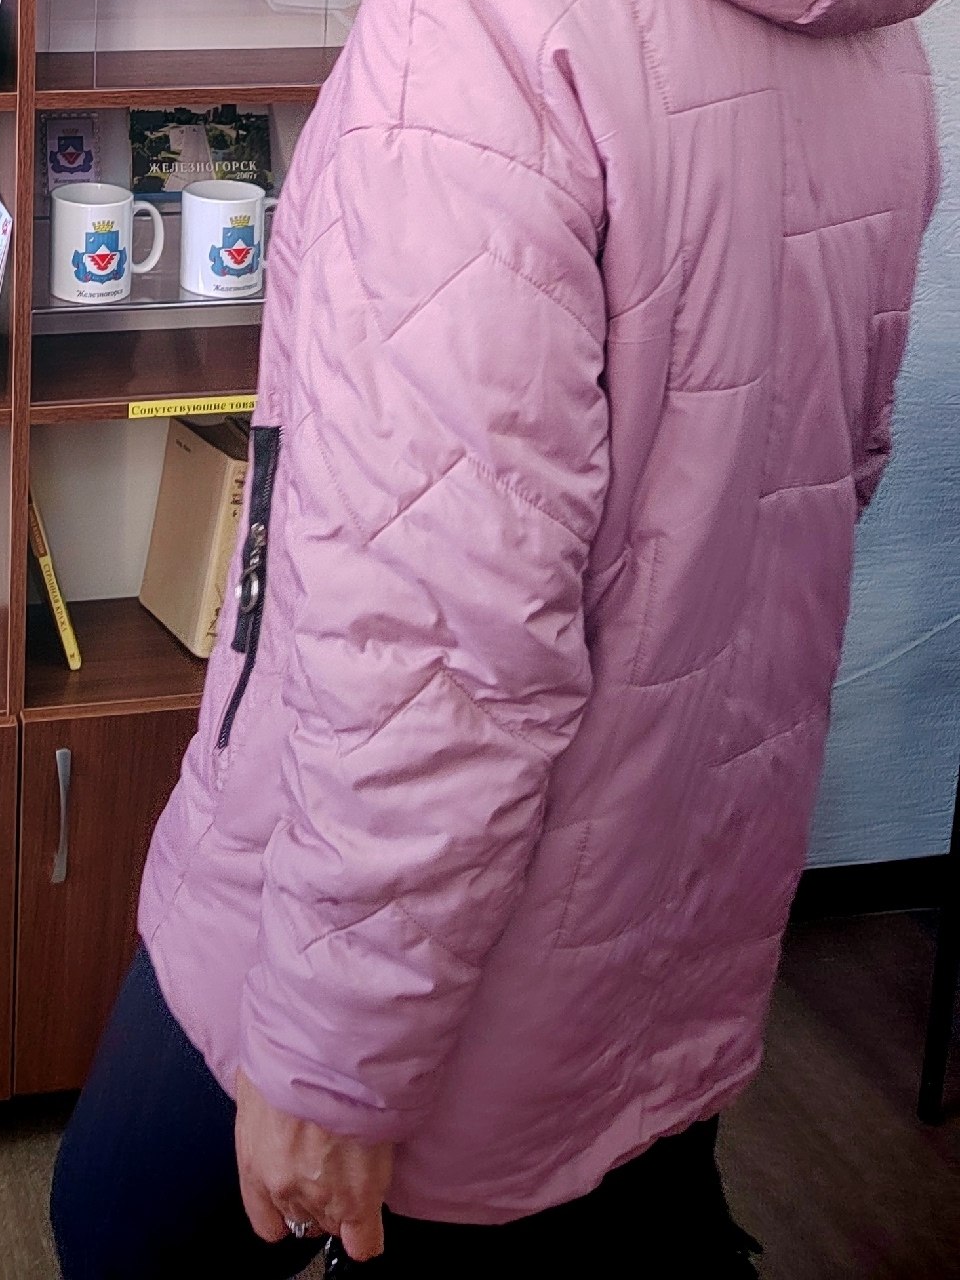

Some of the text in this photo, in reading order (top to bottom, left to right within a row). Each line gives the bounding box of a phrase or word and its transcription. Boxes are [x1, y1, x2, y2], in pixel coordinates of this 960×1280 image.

[149, 160, 257, 174] ЖЕЛЕЗНОГОРСК
[76, 289, 124, 298] Железногорск
[132, 400, 255, 416] Сопутствующие това
